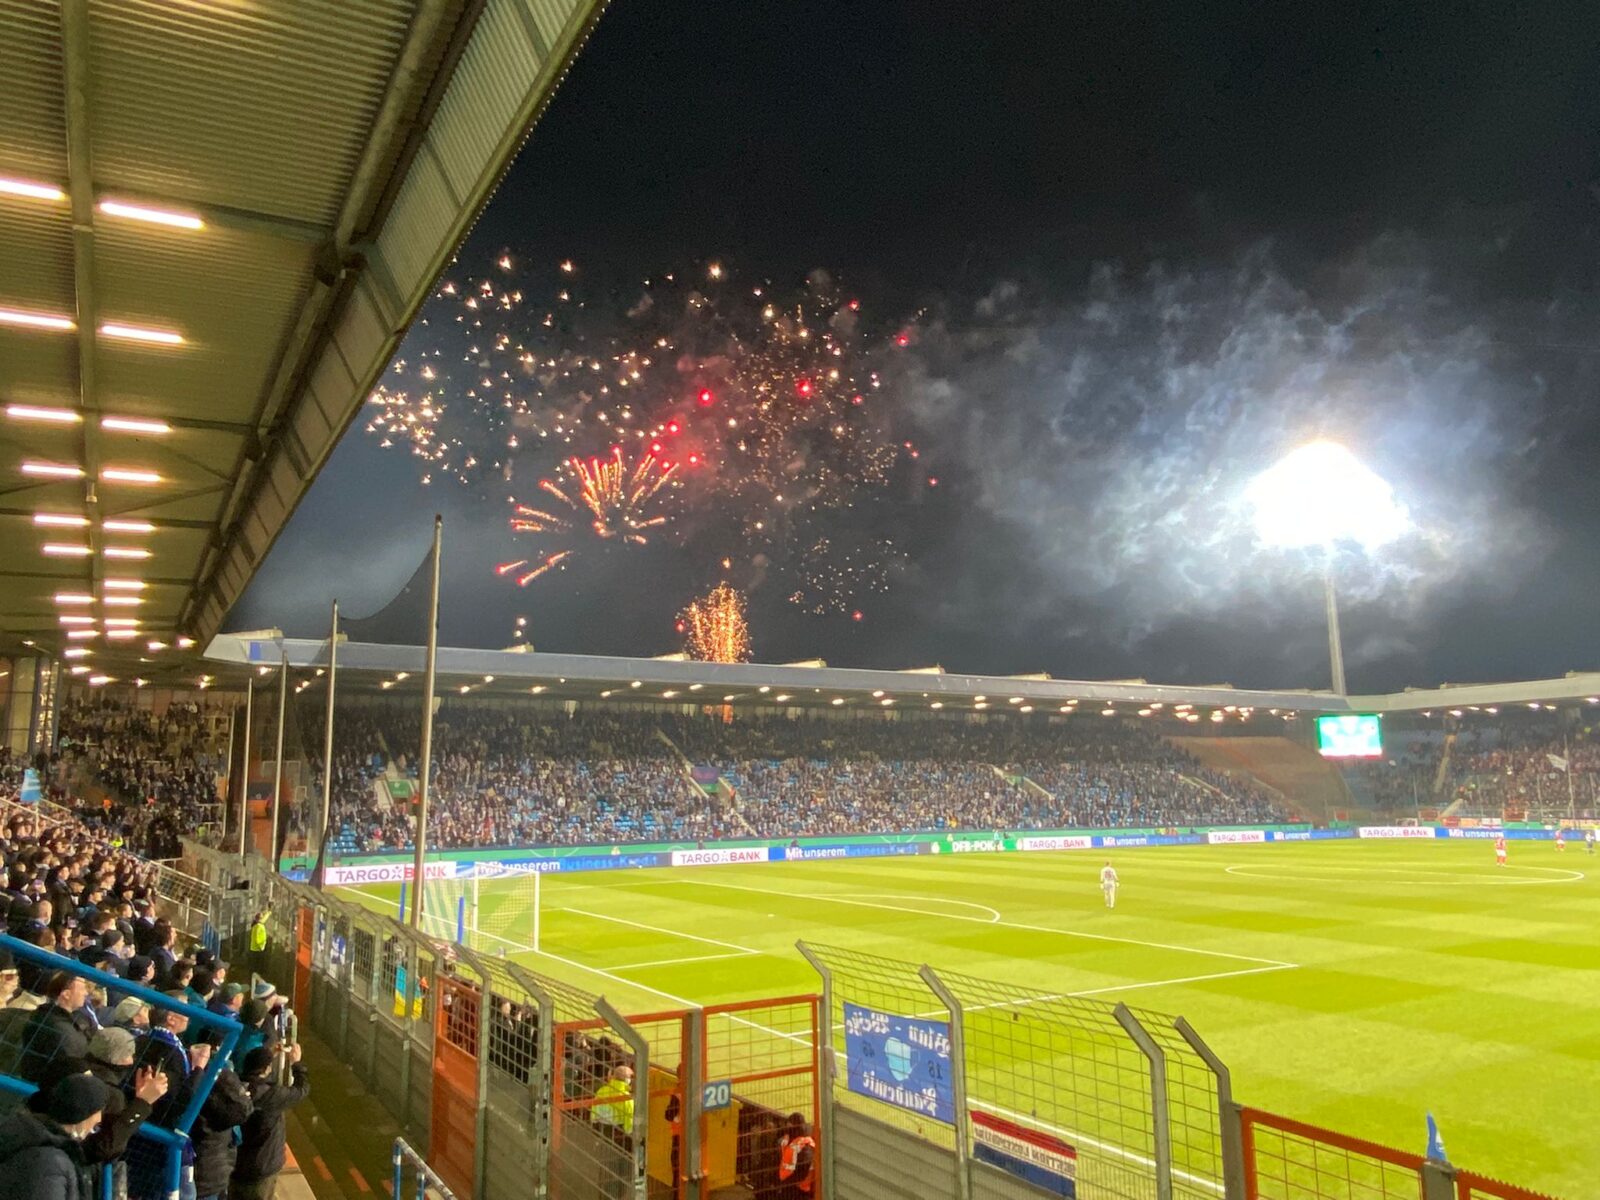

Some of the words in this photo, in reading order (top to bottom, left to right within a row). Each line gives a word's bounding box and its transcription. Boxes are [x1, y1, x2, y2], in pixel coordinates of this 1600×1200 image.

[681, 852, 720, 863] TARGO
[730, 851, 761, 861] BANK
[785, 848, 802, 859] Mit
[804, 848, 846, 857] unserem
[336, 868, 390, 882] TARGO
[403, 865, 447, 879] BNK
[705, 1084, 729, 1108] 20
